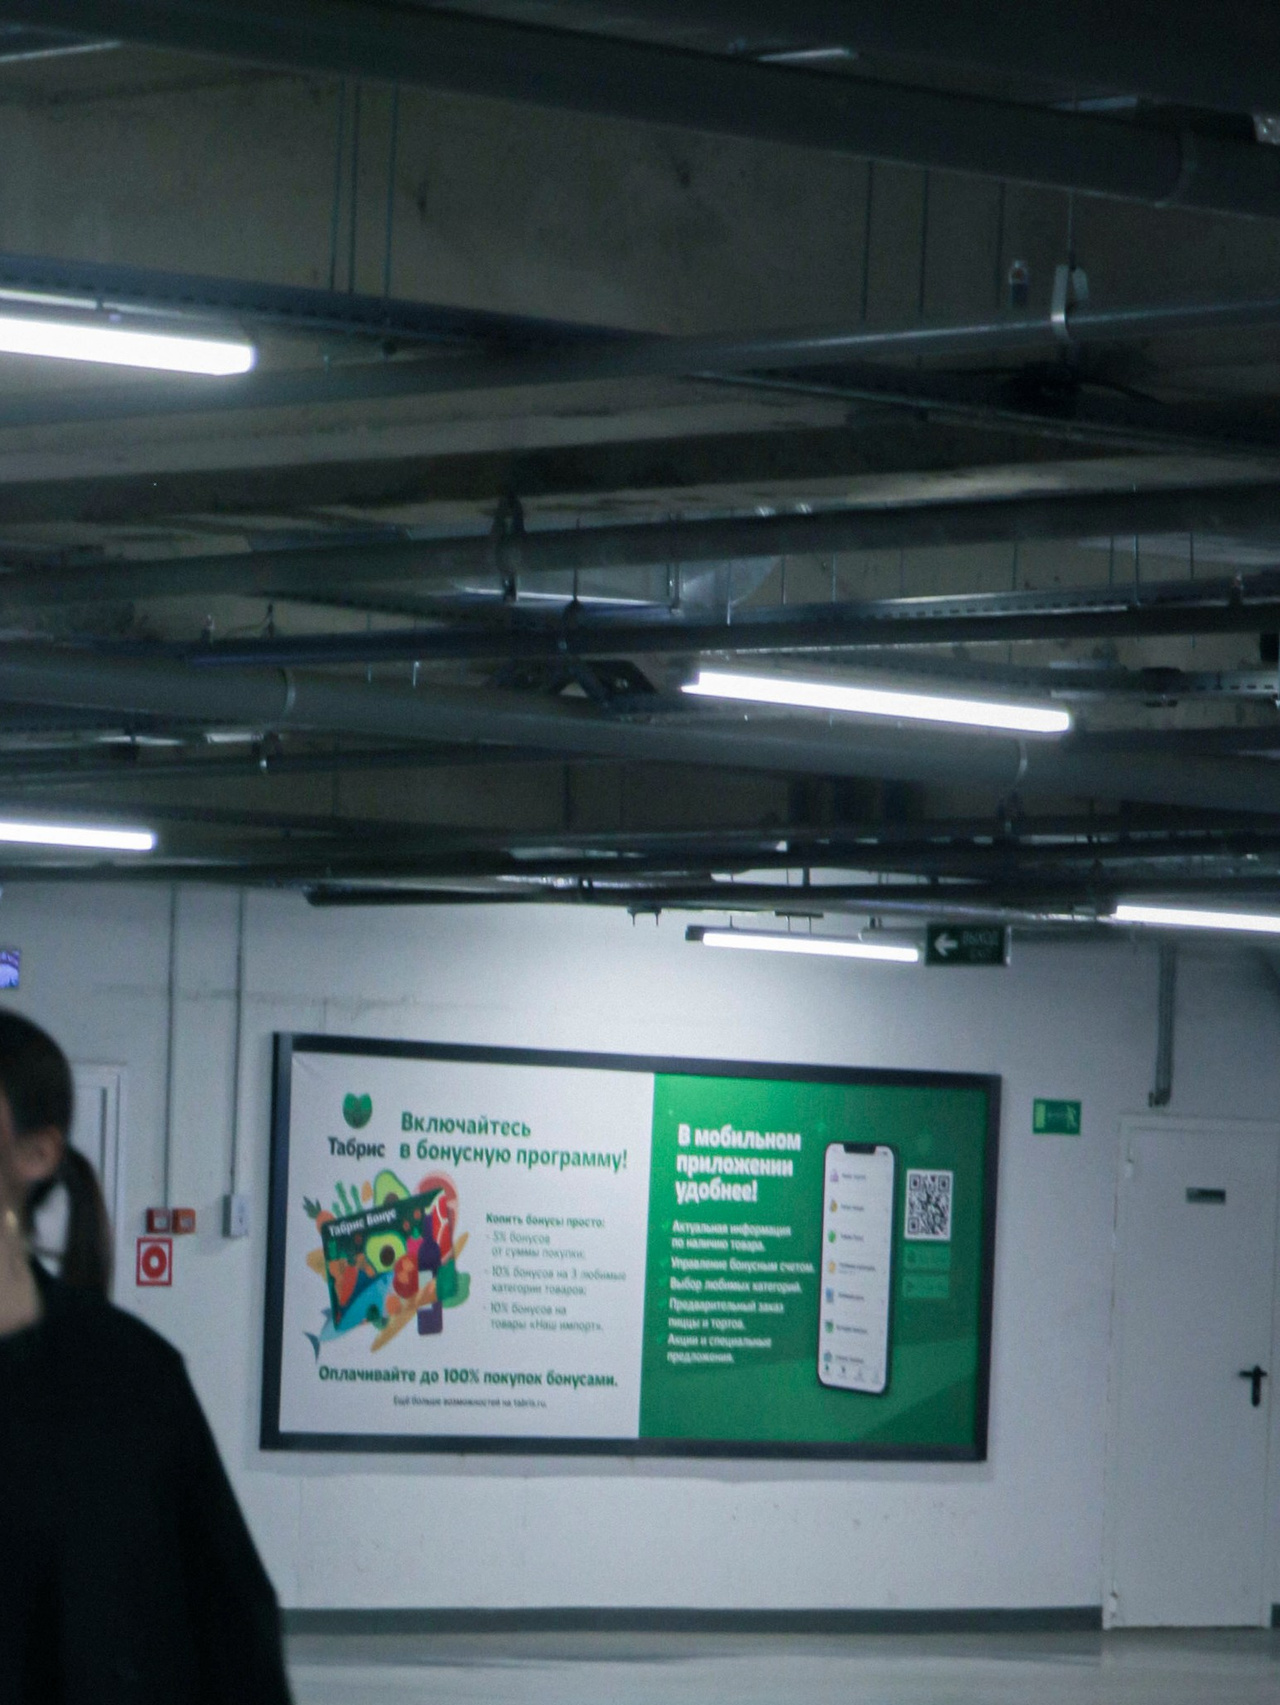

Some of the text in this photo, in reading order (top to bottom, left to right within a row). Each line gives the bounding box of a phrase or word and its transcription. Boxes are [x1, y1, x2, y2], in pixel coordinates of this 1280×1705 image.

[401, 1111, 531, 1137] Включайтесь
[678, 1123, 801, 1151] В мобильном
[327, 1136, 386, 1160] Табрис
[400, 1138, 628, 1173] в бонусную программу!
[676, 1154, 793, 1178] приложении
[675, 1176, 758, 1205] удобнее!
[328, 1208, 397, 1237] Табрис Бонус
[486, 1213, 523, 1225] Копить
[526, 1213, 564, 1227] бонусы
[672, 1219, 791, 1237] Актуальная информация
[510, 1232, 550, 1244] бонусов
[672, 1238, 684, 1249] по
[492, 1247, 502, 1256] от
[513, 1266, 554, 1279] бонусов
[556, 1270, 568, 1279] на
[671, 1256, 727, 1271] Управление
[729, 1257, 778, 1272] бонусным
[670, 1276, 703, 1292] Выбор
[704, 1278, 750, 1292] любимых
[511, 1302, 553, 1315] бонусов
[555, 1306, 567, 1315] на
[669, 1297, 756, 1313] Предварительный
[319, 1365, 618, 1390] Оплачивайте до 100% покупок бонусами.
